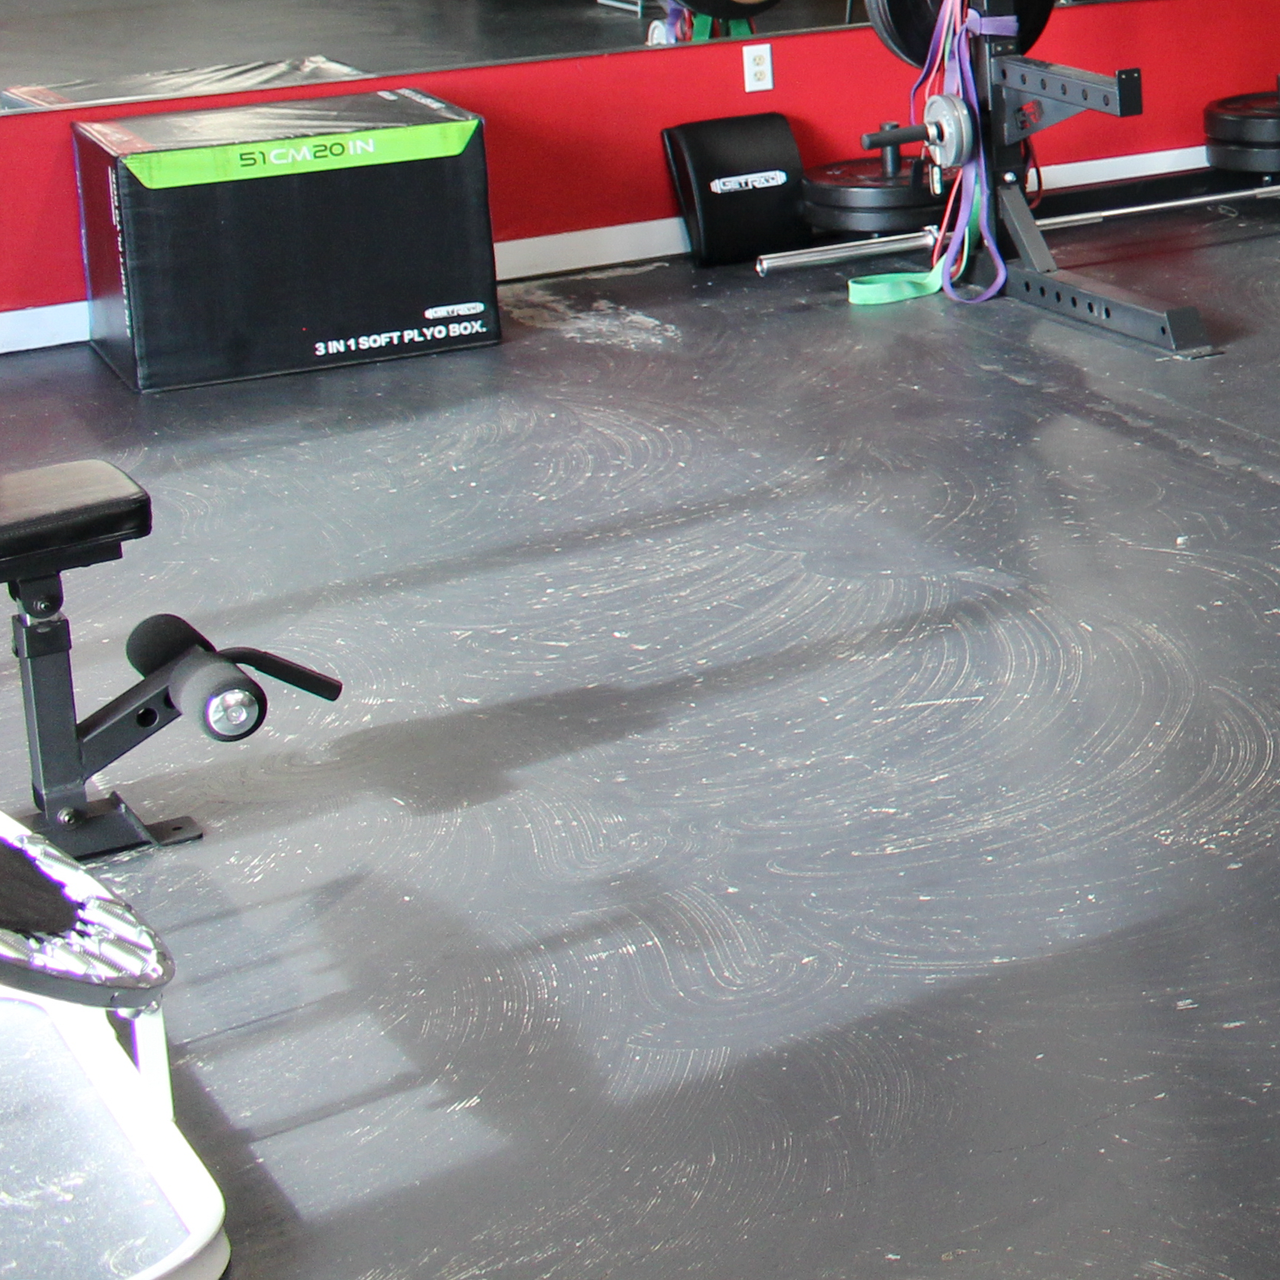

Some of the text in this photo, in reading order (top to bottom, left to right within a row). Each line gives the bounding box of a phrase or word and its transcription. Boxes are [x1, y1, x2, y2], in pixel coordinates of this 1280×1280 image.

[314, 341, 326, 356] 3
[328, 339, 345, 354] IN
[347, 336, 356, 352] 1
[358, 331, 401, 350] SOFT
[403, 326, 447, 344] PLYO
